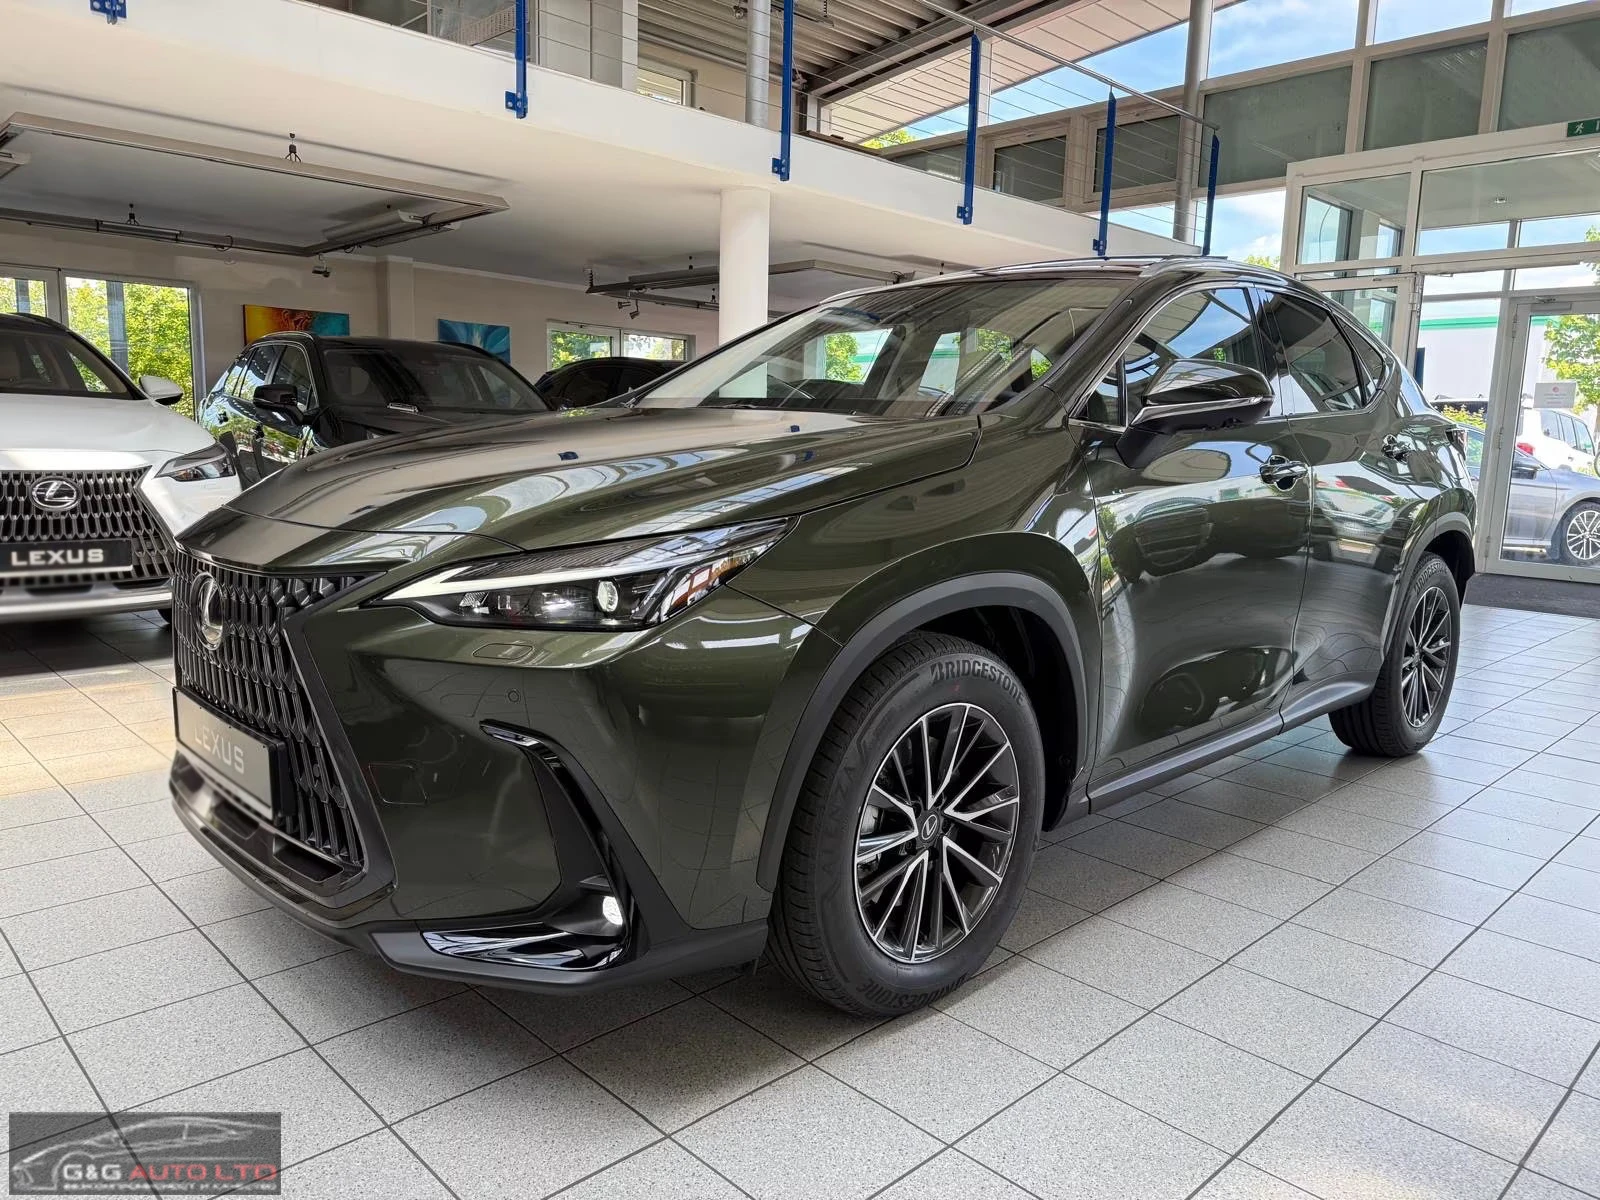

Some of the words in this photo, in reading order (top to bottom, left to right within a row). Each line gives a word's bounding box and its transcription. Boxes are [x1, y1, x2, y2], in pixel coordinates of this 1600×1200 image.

[10, 548, 104, 567] LEXUS
[930, 659, 1025, 705] BRIDGESTONE
[194, 726, 245, 775] LEXUS
